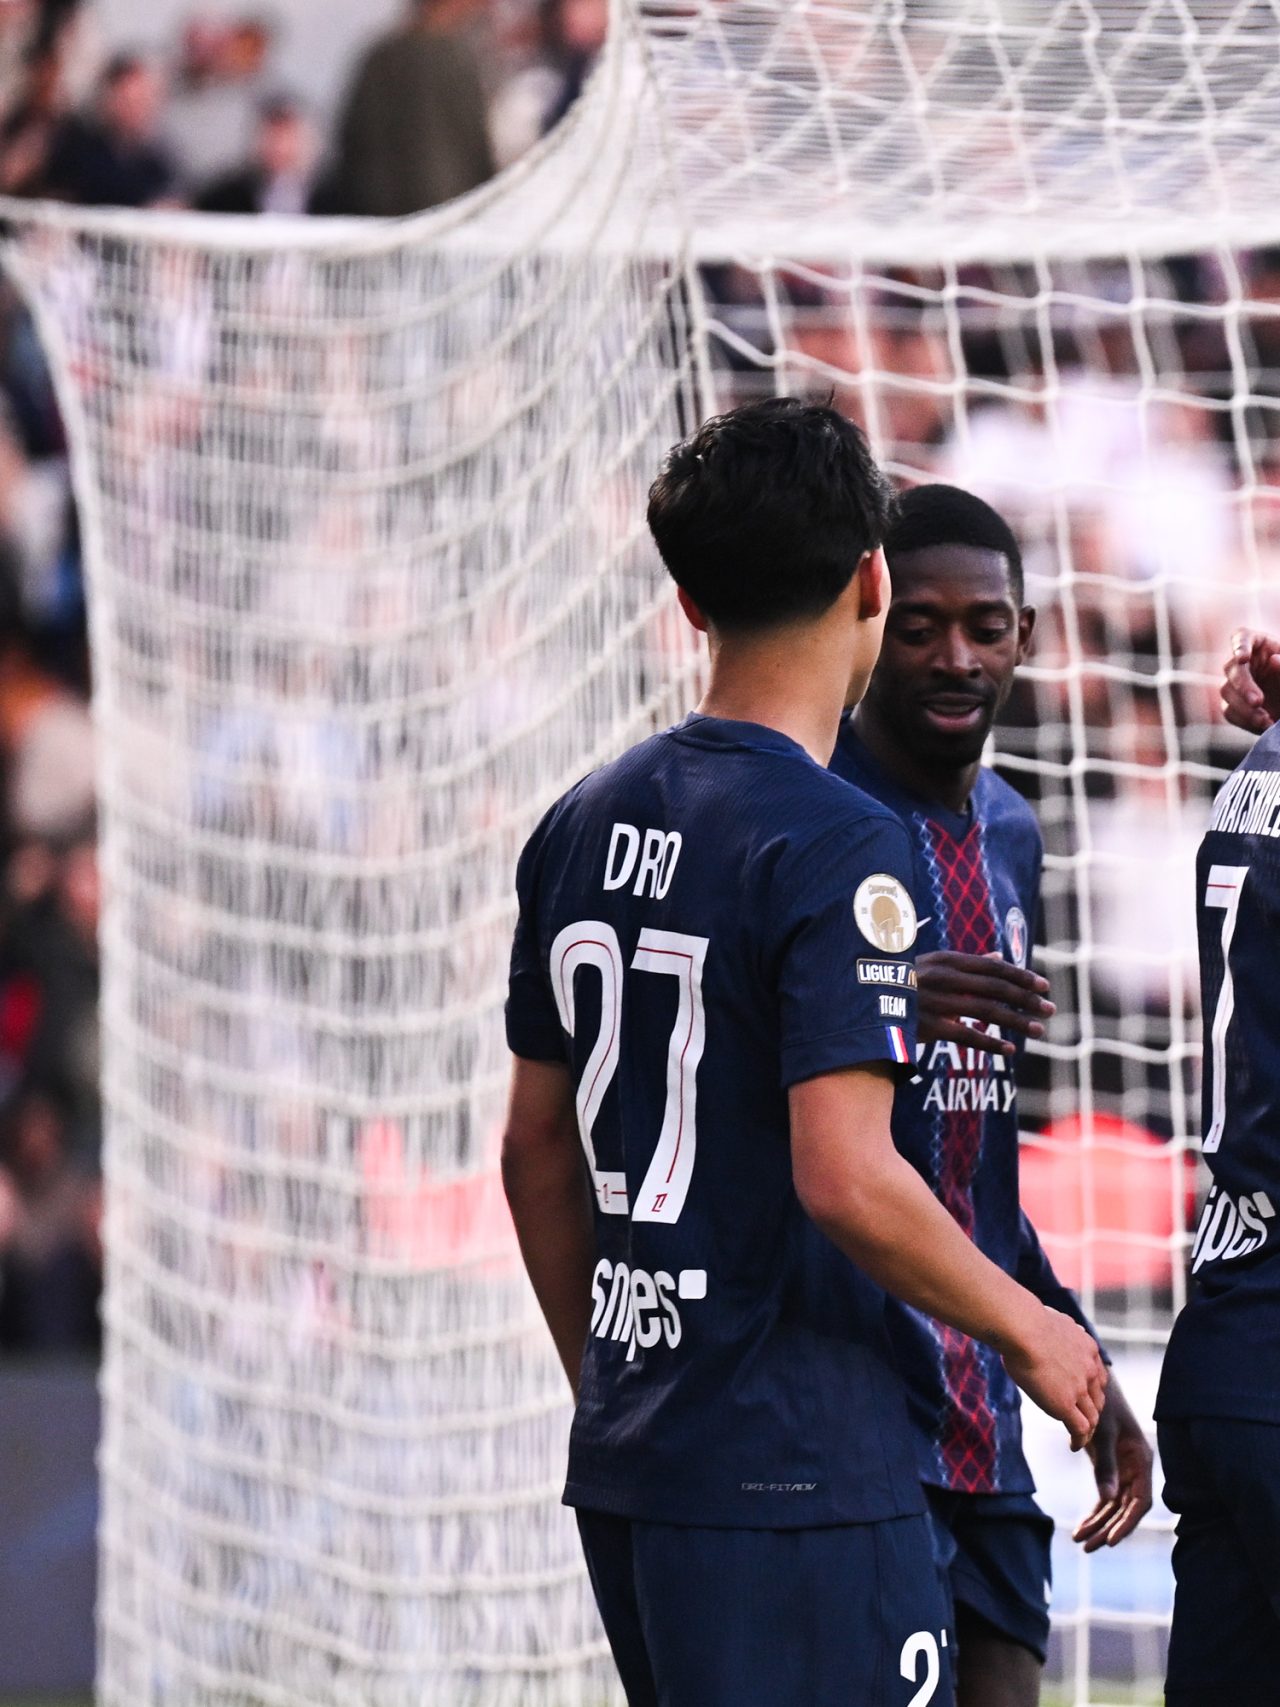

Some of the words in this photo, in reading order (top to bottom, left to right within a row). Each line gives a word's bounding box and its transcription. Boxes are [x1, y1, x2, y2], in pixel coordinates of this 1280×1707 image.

[603, 823, 682, 900] DRO
[859, 964, 896, 982] LIGUE
[1202, 864, 1249, 1152] 7
[550, 920, 709, 1224] 27
[900, 1628, 948, 1707] 2
